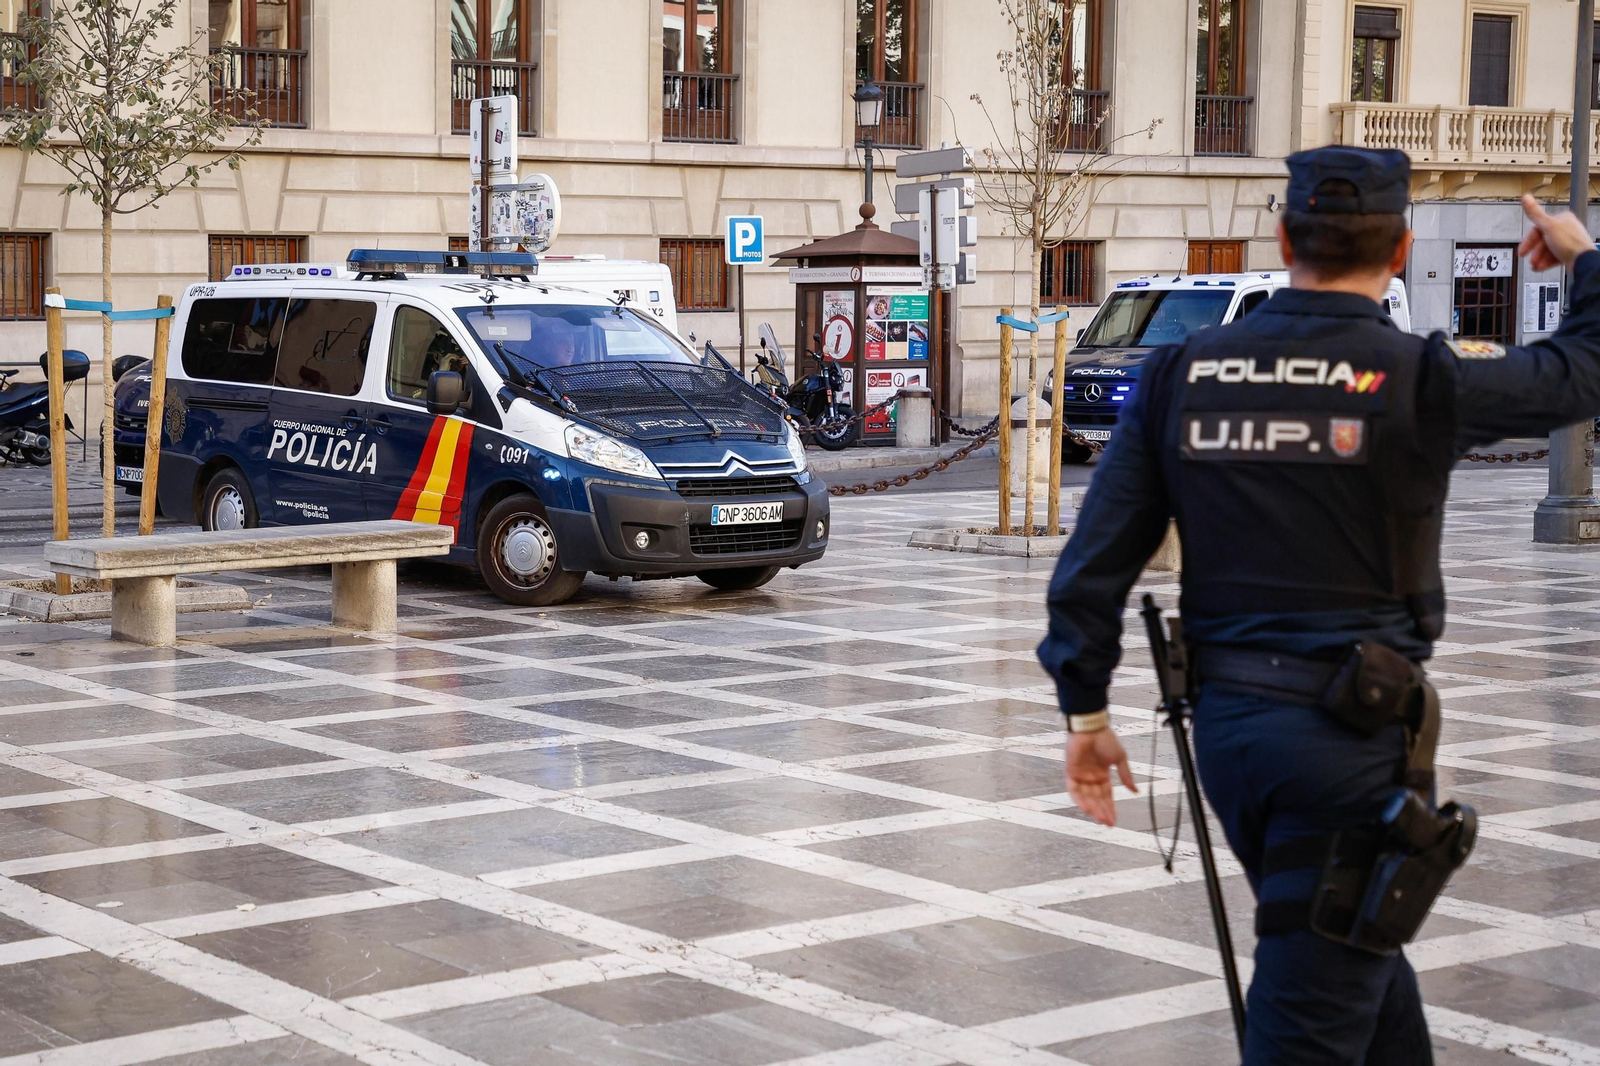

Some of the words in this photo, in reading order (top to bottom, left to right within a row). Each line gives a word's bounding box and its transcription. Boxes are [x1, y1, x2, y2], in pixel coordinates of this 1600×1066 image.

[735, 222, 757, 258] P
[1187, 358, 1356, 385] POLICIA
[273, 419, 301, 430] CUERPO
[301, 423, 335, 435] NACIONAL
[336, 428, 348, 437] DE
[635, 418, 748, 431] POLCIA
[1076, 430, 1111, 440] P7038AX
[1189, 419, 1321, 453] U.I.P.
[266, 428, 377, 475] POLICÍA
[506, 446, 530, 465] 091
[275, 499, 329, 512] www.policia.es
[302, 509, 330, 520] @policia
[719, 508, 740, 523] CNP
[741, 506, 768, 522] 3606
[768, 505, 783, 521] AM
